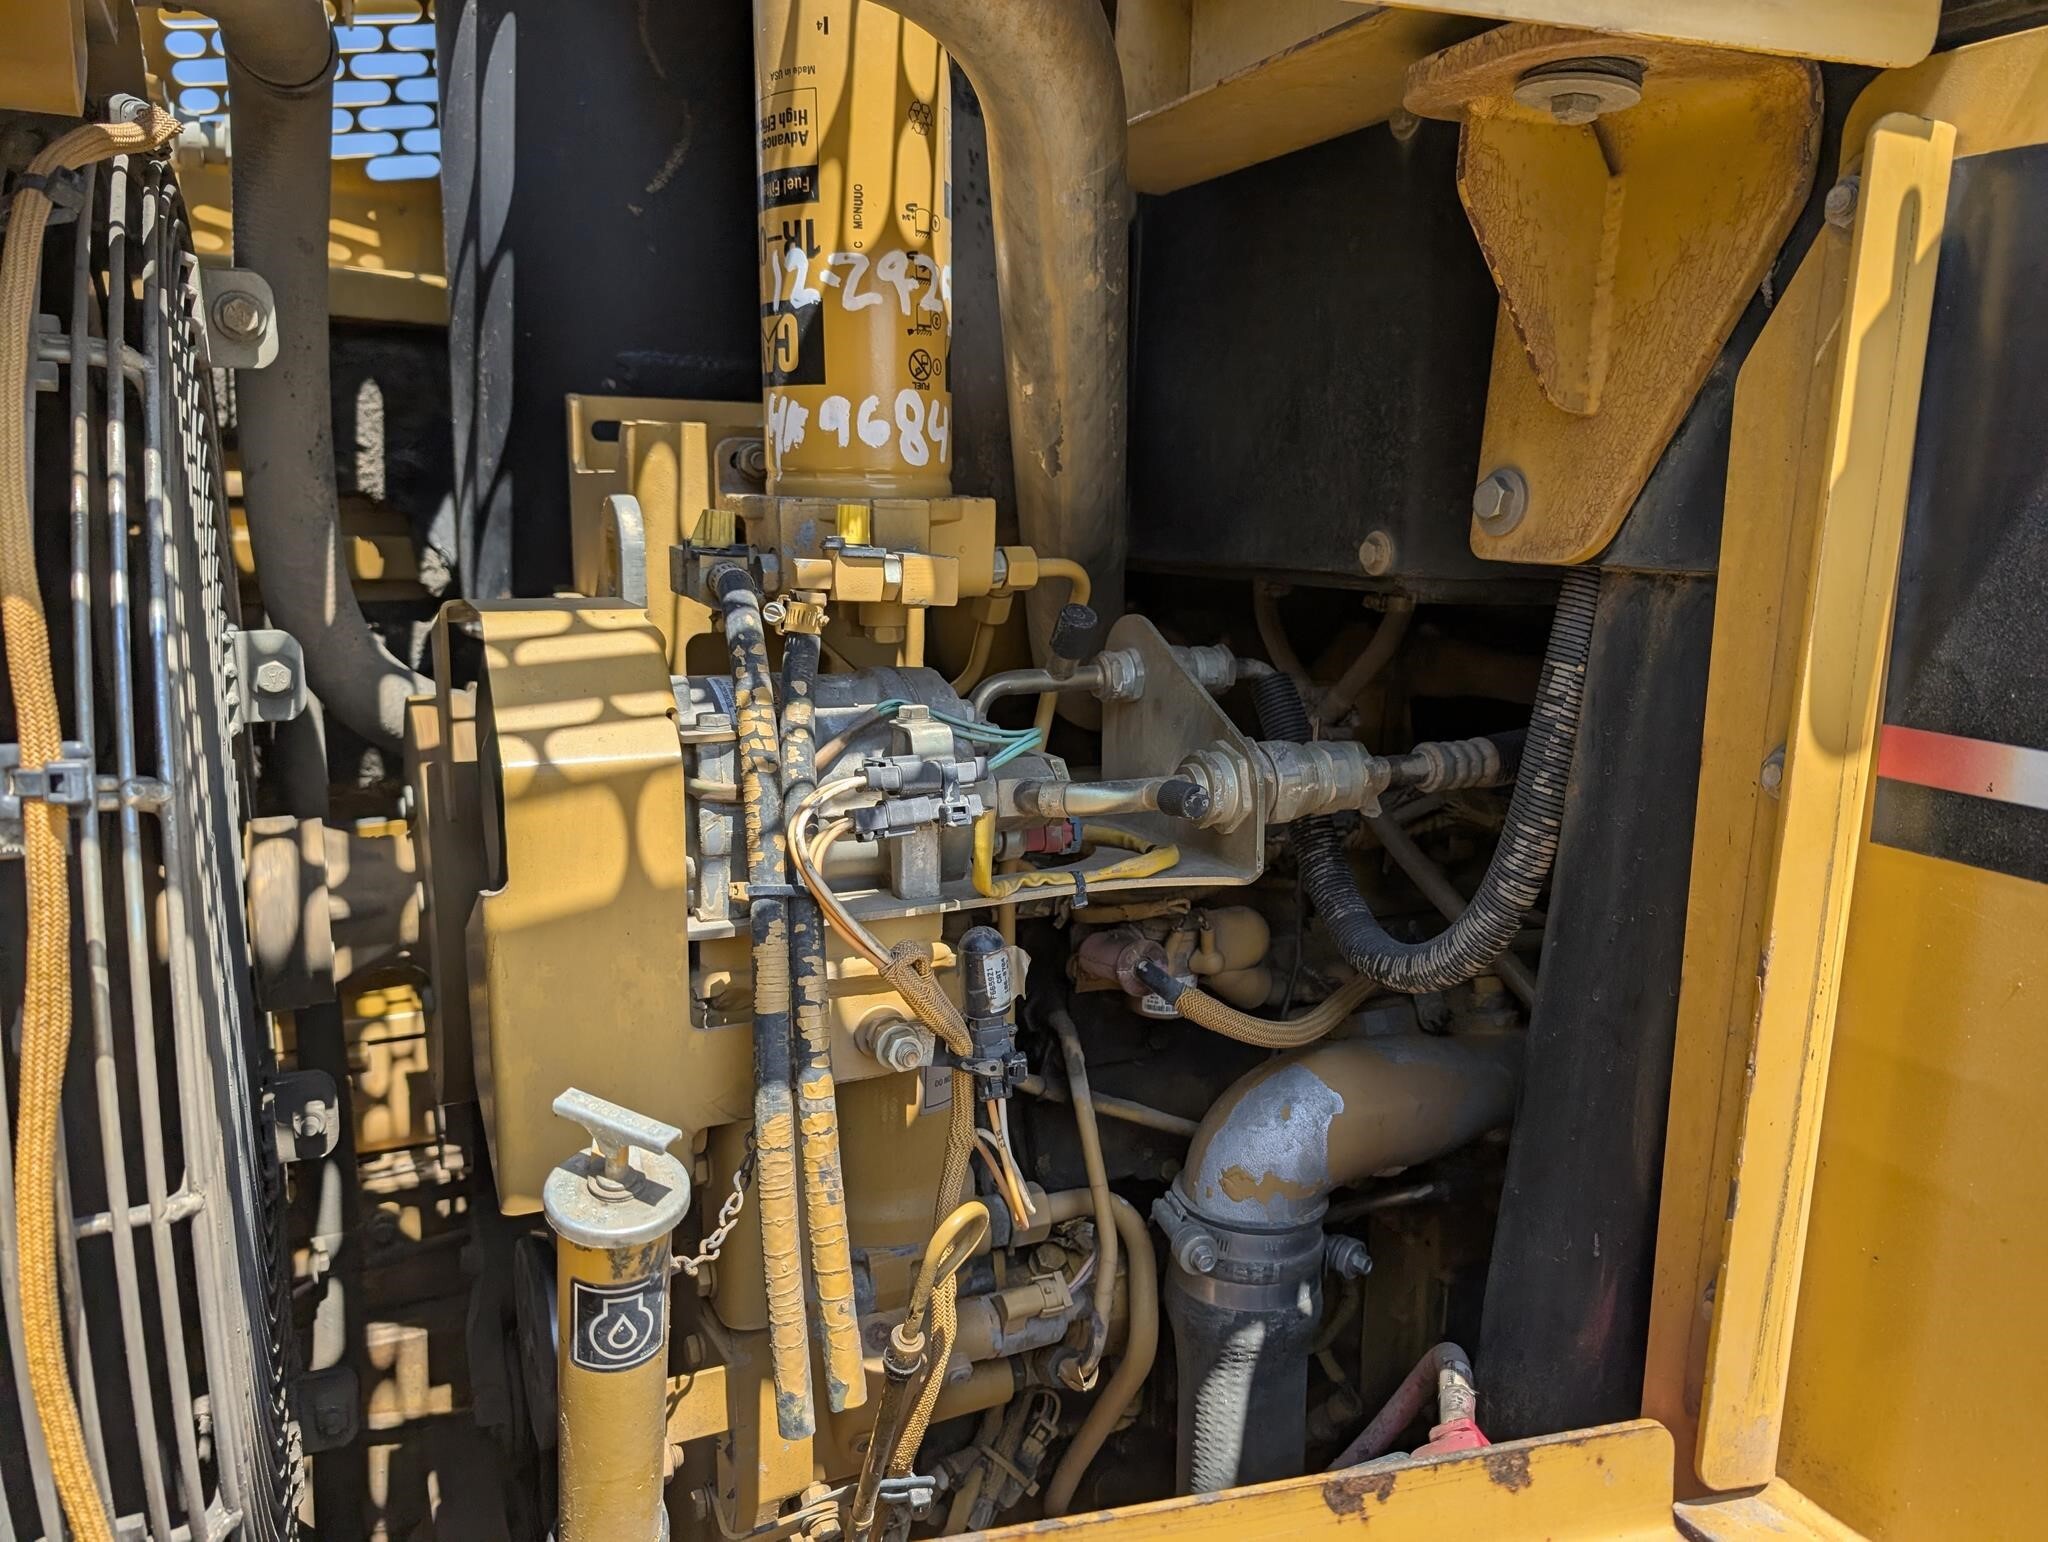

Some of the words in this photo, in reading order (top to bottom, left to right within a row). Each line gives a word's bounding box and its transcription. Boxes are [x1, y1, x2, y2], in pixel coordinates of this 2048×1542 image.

[770, 69, 784, 81] USA
[785, 68, 792, 76] in
[793, 65, 816, 75] Made
[779, 107, 808, 129] High
[762, 130, 809, 151] Advance
[784, 176, 810, 195] Fuel
[912, 381, 930, 391] FUEL
[819, 388, 948, 467] 9684
[995, 970, 1003, 984] CAT
